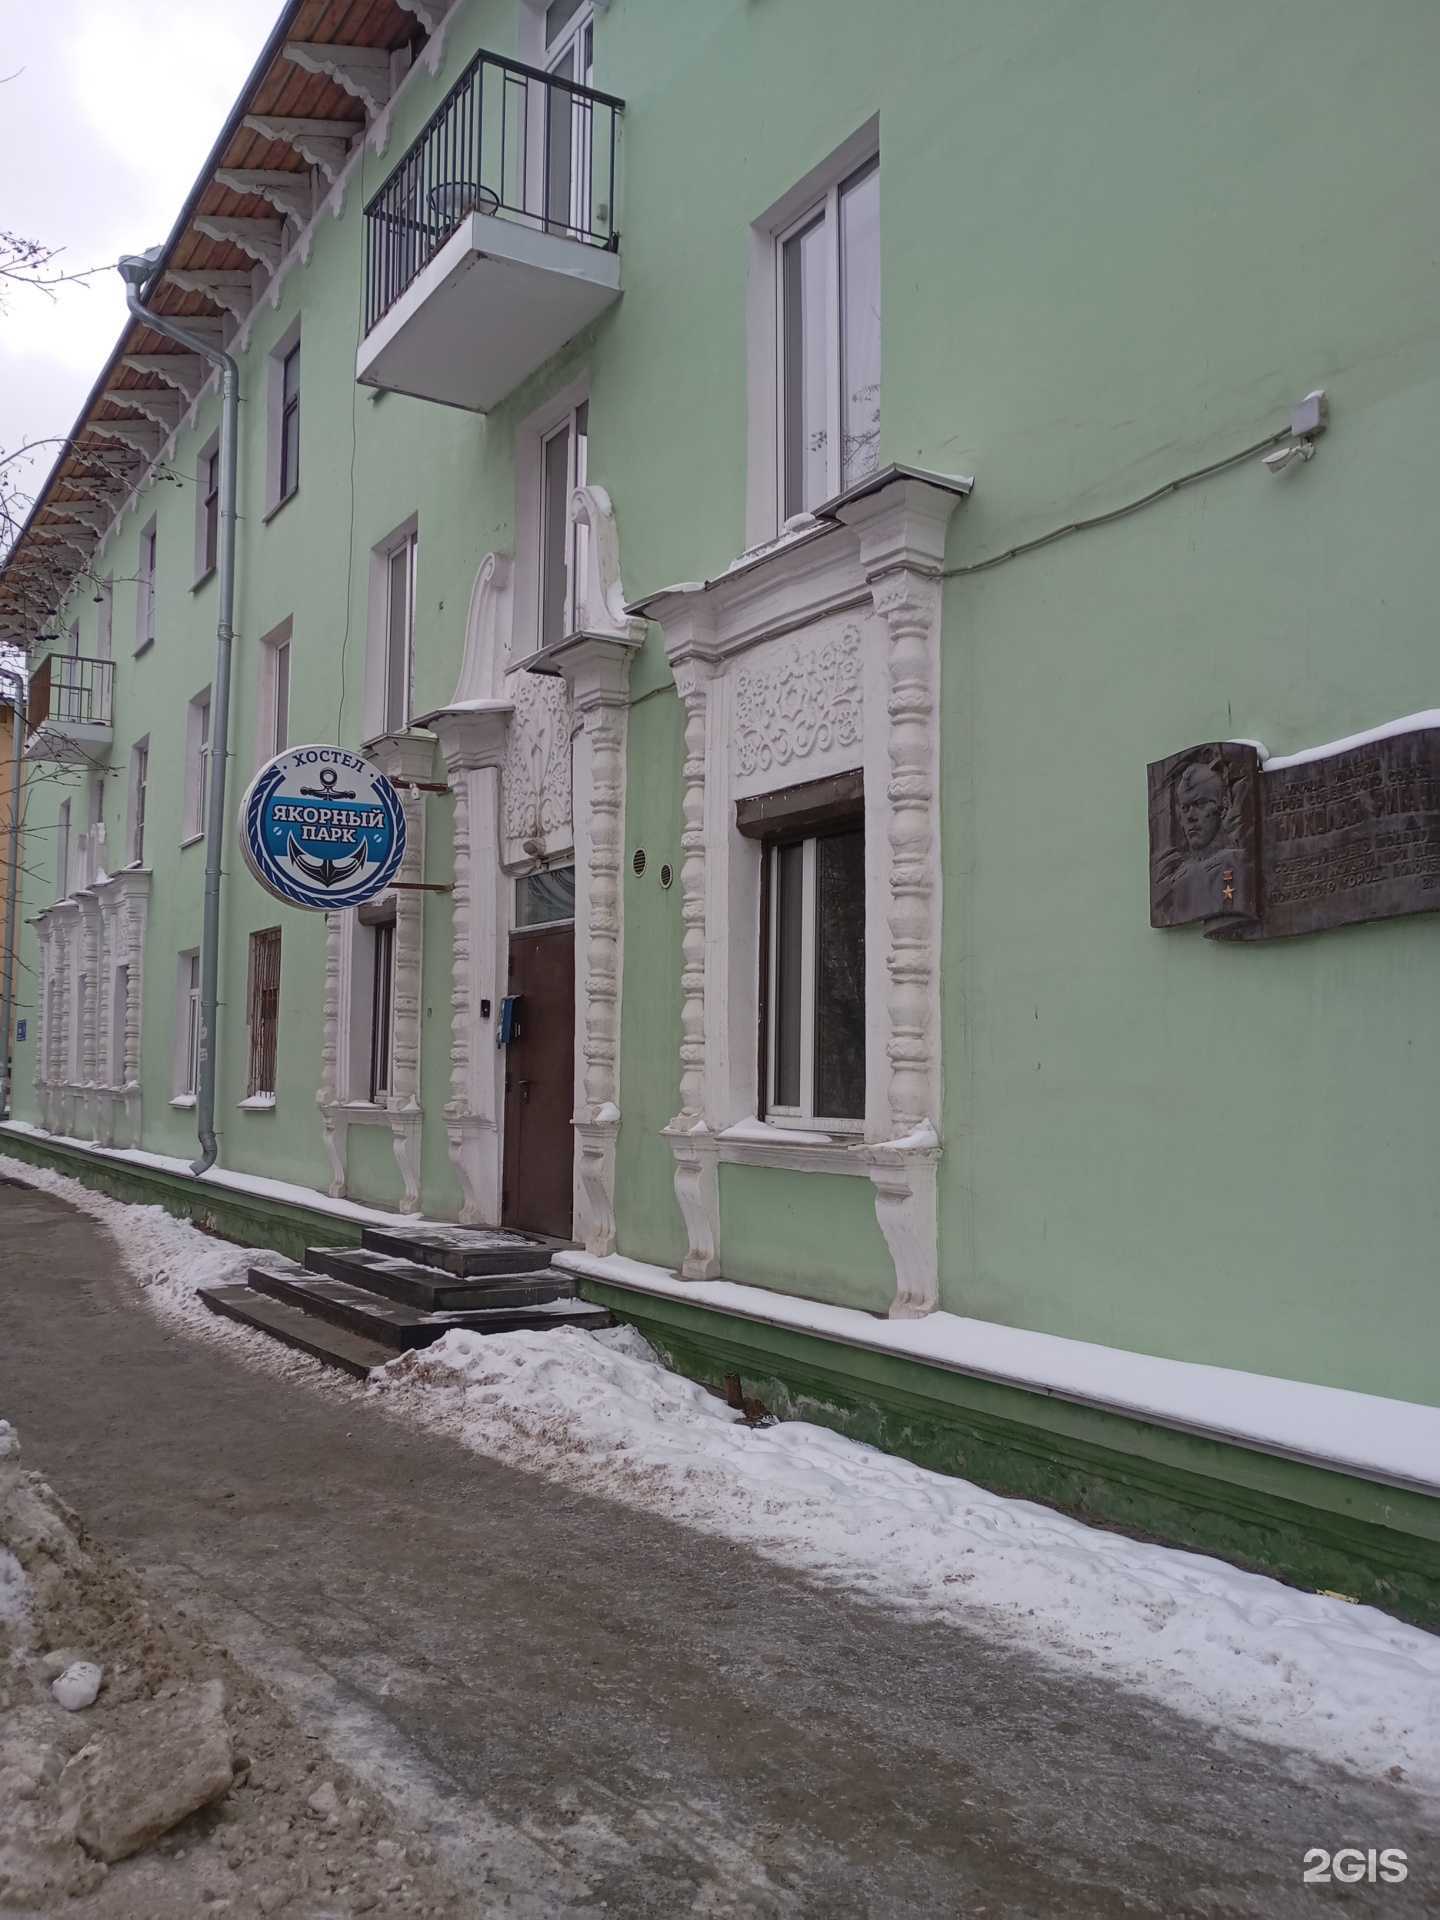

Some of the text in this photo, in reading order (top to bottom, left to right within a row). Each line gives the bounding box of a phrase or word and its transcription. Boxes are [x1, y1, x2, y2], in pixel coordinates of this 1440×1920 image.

[292, 750, 366, 774] ХОСТЕЛ
[272, 804, 384, 829] ЯКОРНЫЙ
[301, 824, 357, 843] ПАРК
